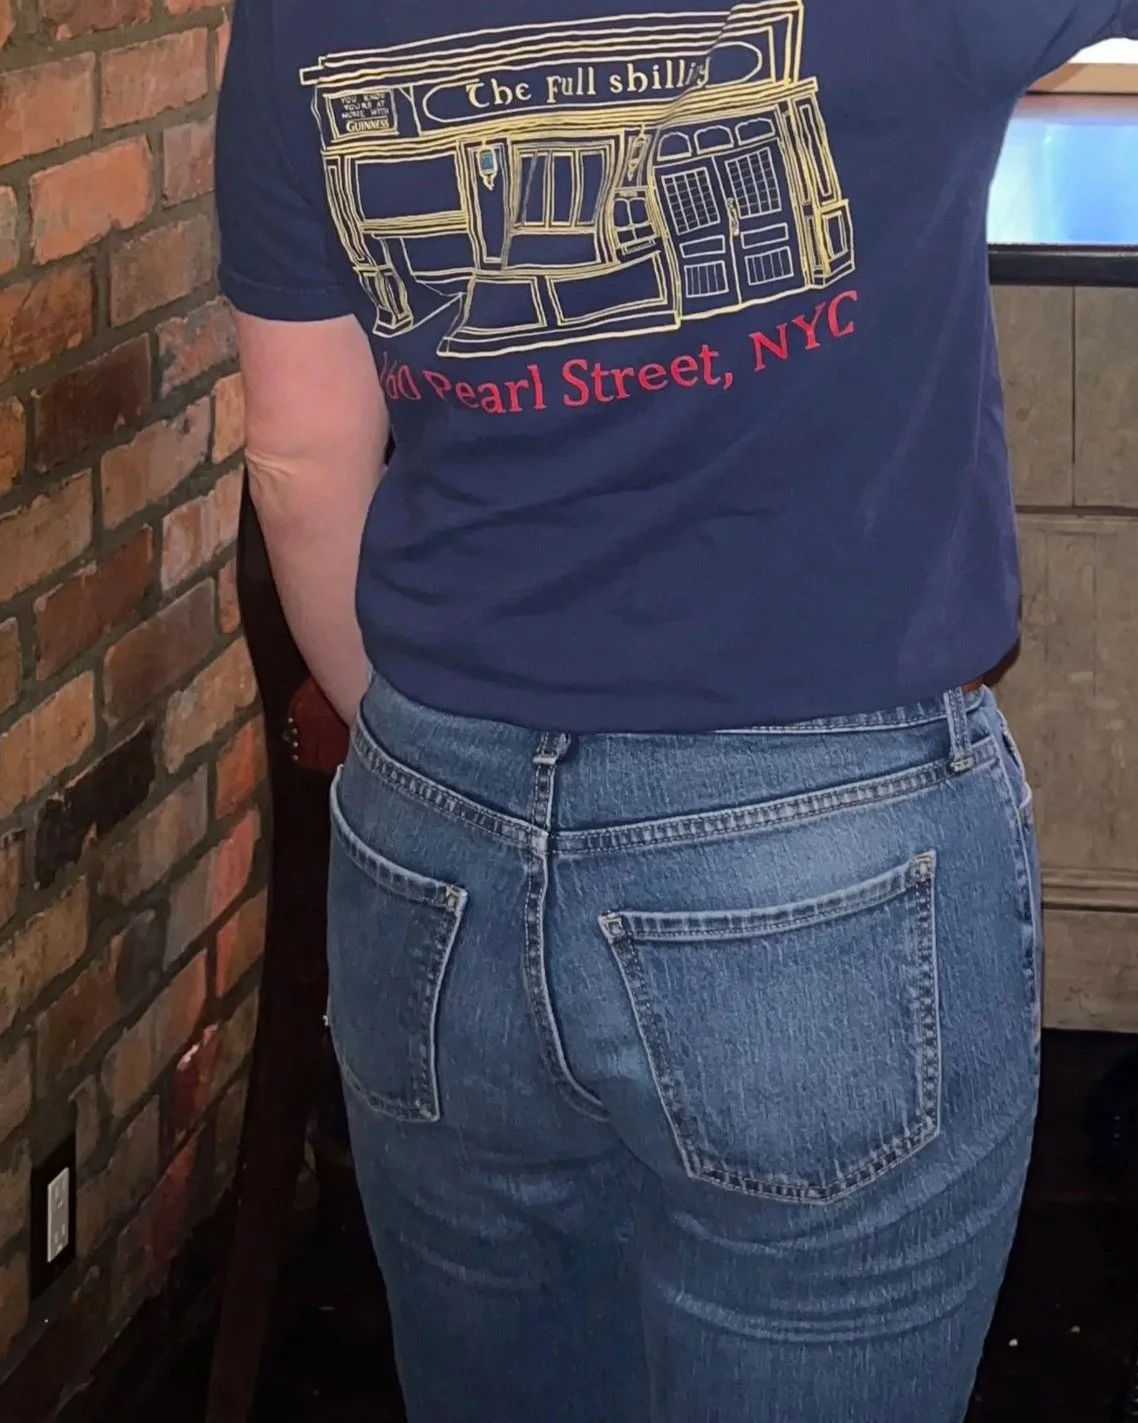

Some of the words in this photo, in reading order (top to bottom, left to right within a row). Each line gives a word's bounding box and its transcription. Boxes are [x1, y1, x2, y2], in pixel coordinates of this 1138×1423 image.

[341, 96, 357, 104] YOU
[466, 78, 532, 108] The
[346, 120, 390, 132] GUINNESS
[422, 364, 548, 414] Pearl
[562, 344, 734, 407] Street,
[748, 290, 859, 372] NYC
